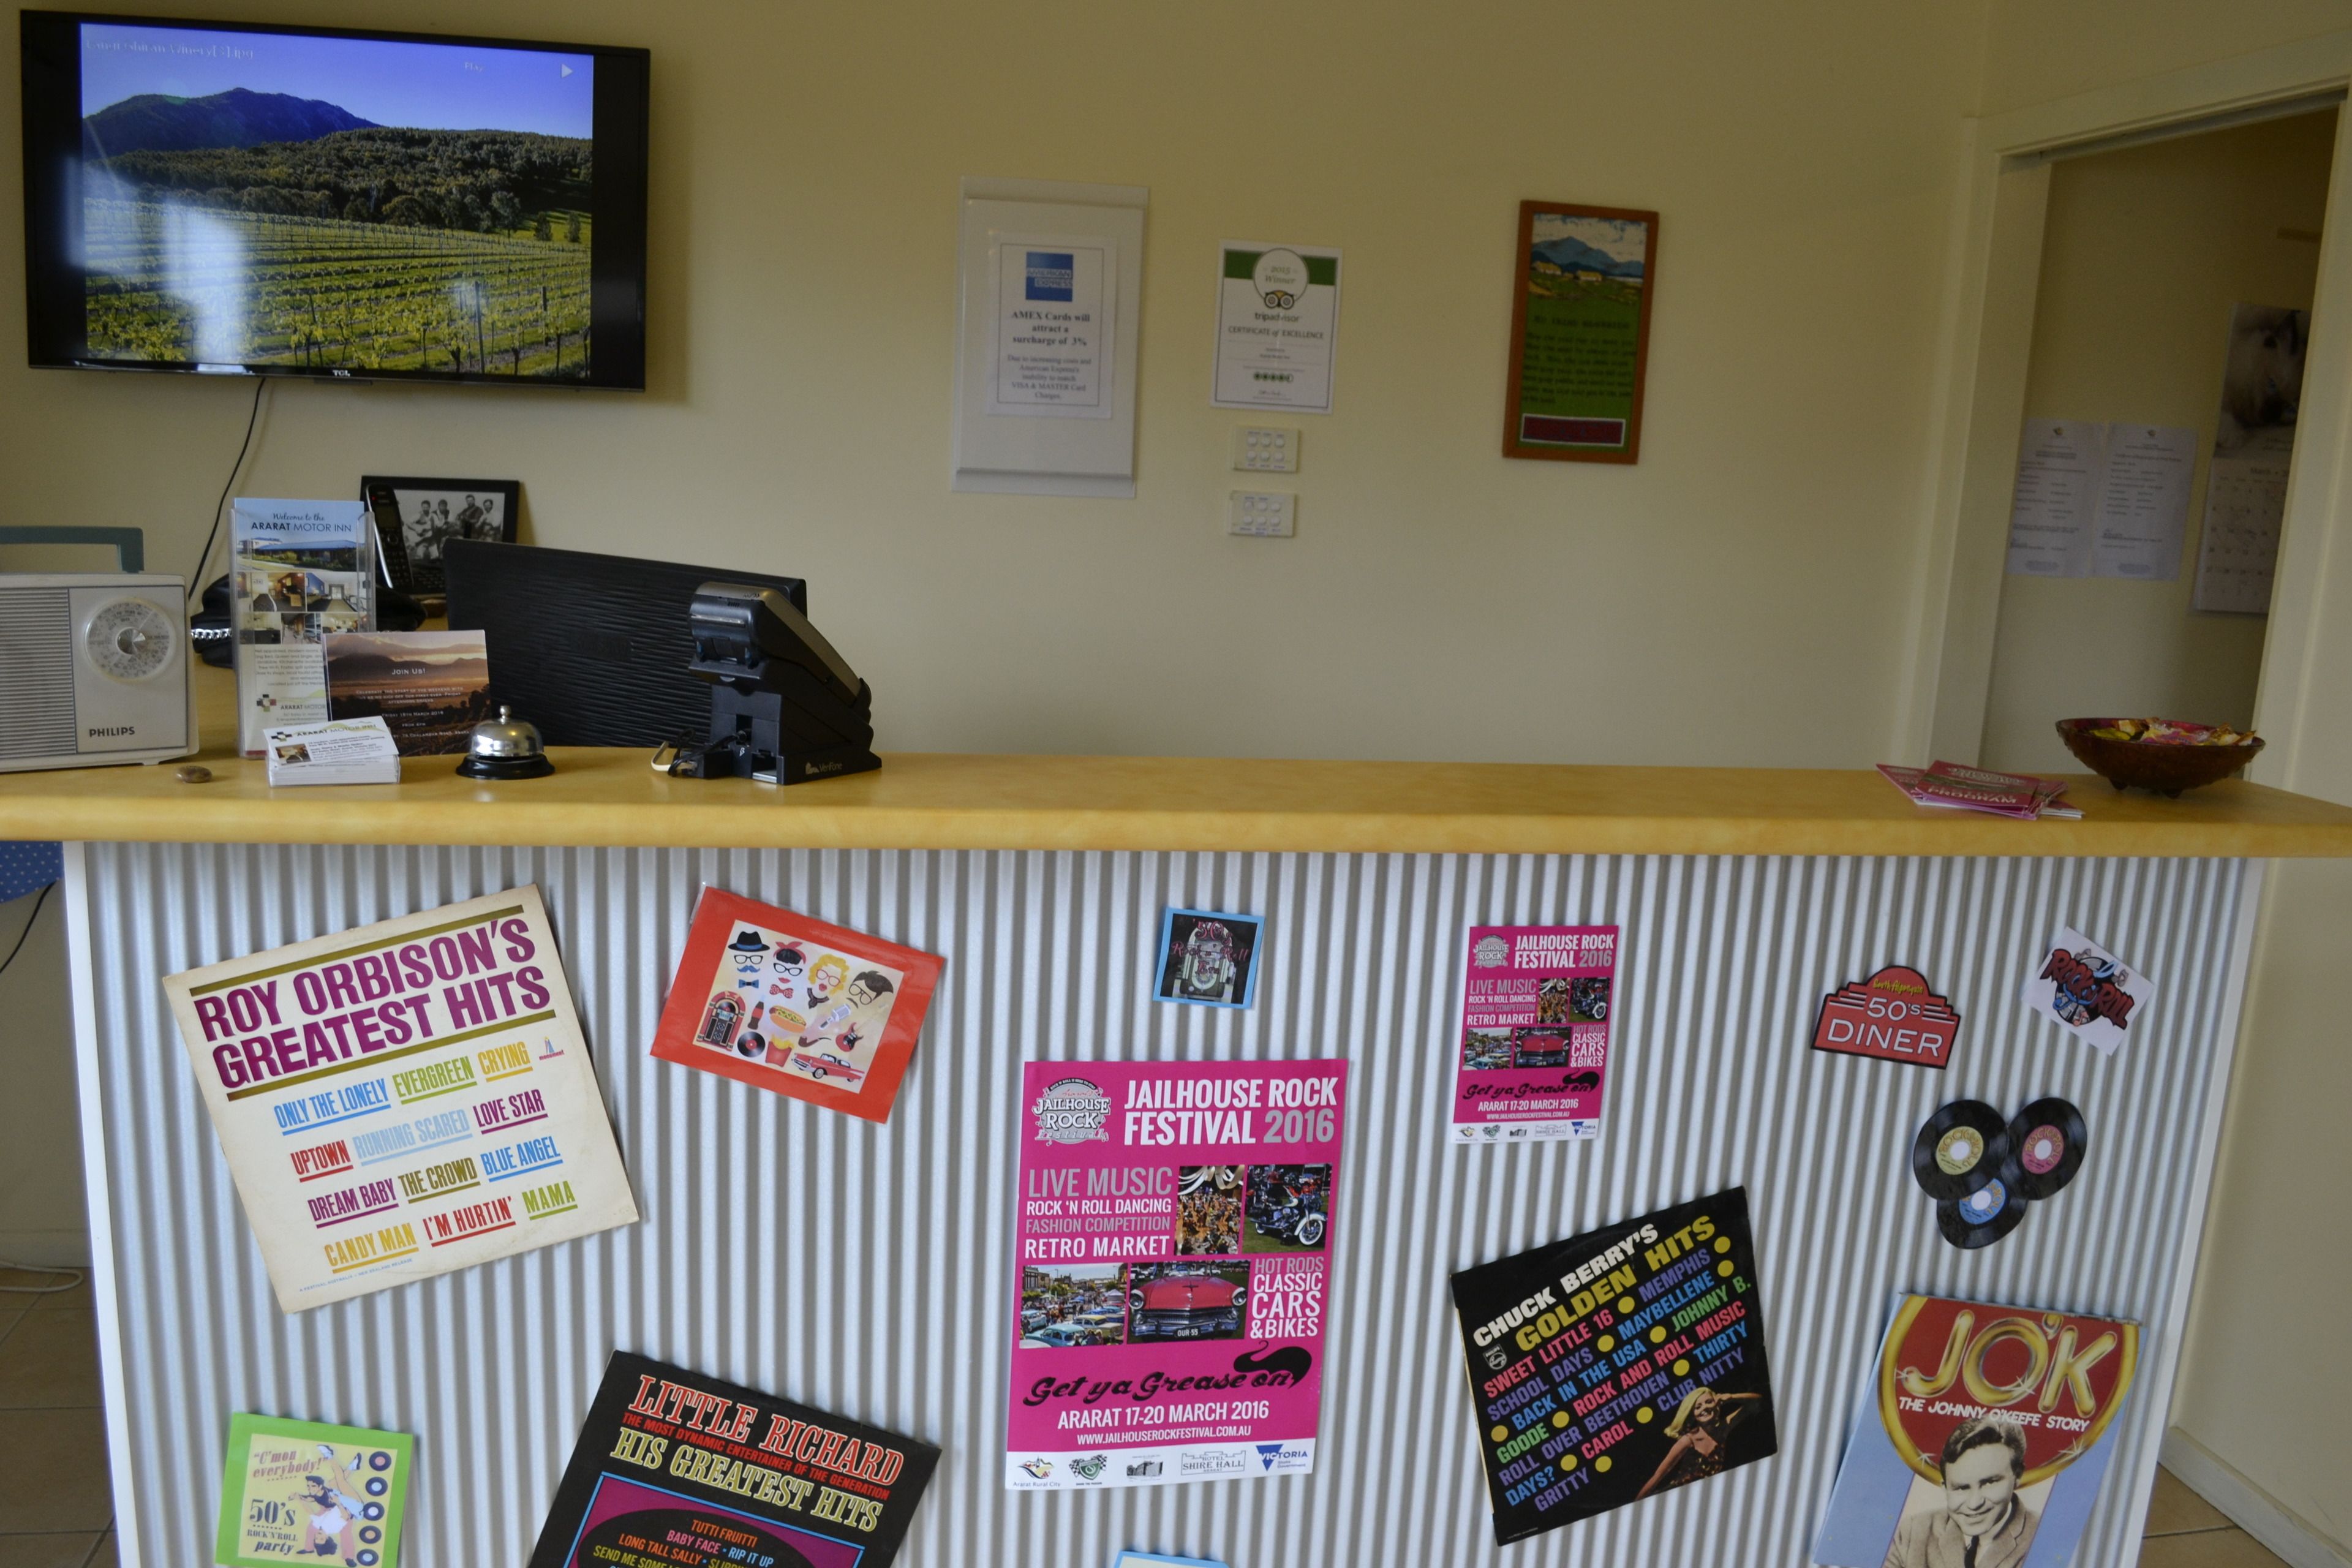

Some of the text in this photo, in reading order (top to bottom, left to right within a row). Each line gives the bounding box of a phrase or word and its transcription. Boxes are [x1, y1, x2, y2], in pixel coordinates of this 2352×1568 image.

[1027, 268, 1071, 277] AMERICAN
[1036, 279, 1073, 287] EXPRESS
[1011, 311, 1042, 320] AMEX
[1045, 312, 1071, 321] Cards
[1012, 337, 1056, 345] surcharge
[1071, 337, 1087, 346] 3%
[1229, 326, 1270, 336] CERTIFICATE
[1283, 330, 1324, 339] EXCELLENCE
[251, 522, 290, 530] ARARAT
[294, 523, 331, 532] MOTOR
[89, 726, 135, 737] PHILIPS
[818, 761, 843, 772] VeriFone
[1515, 934, 1615, 951] JAILHOUSE ROCK
[1514, 951, 1612, 968] FESTIVAL 2016
[194, 919, 535, 1042] ROY ORBISON'S
[213, 966, 551, 1088] GREATEST HITS
[1827, 1019, 1943, 1057] DINER
[1570, 1057, 1603, 1068] &BIKES
[274, 1041, 531, 1128] ONLY THE LONELY EVERGREEN CRYING
[1124, 1079, 1264, 1110] JAILHOUSE
[1268, 1077, 1338, 1107] ROCK
[1033, 1098, 1109, 1115] JAILHOUSE
[1487, 1112, 1570, 1120] WWW.JAILHOUSEROCKFESTIVAL.COM.AU
[290, 1088, 546, 1175] UPTOWN RUNNING SCARED LOVE STAR
[1045, 1112, 1098, 1131] ROCK
[1124, 1108, 1335, 1146] FESTIVAL 2016
[307, 1136, 561, 1222] DREAM BABY THE CROWD BLUE ANGEL
[1028, 1167, 1172, 1199] LIVE MUSIC
[1115, 1198, 1172, 1214] DANCING
[324, 1180, 575, 1267] CANDY MAN HURTIN' MAMA
[1025, 1216, 1170, 1234] FASHION COMPETITION
[1024, 1235, 1170, 1259] RETRO MARKET
[1253, 1272, 1322, 1293] CLASSIC
[1473, 1223, 1658, 1347] CHUCK BERRY'S
[1515, 1215, 1715, 1351] GOLDEN HITS
[1251, 1292, 1321, 1319] CARS
[1250, 1318, 1319, 1340] &BIKES
[1483, 1248, 1711, 1398] SWEET LITTLE 16 MEMPHIS
[1487, 1270, 1715, 1421] SCHOOL DAYS MAYBELLENE
[1511, 1275, 1752, 1431] BACK THE USA JOHNNY B.
[1692, 1320, 1747, 1363] THIRTY
[1901, 1309, 2117, 1418] JO'K
[1023, 1371, 1246, 1406] Get ya Grease
[1058, 1405, 1164, 1430] ARARAT 17-20
[1505, 1347, 1744, 1507] DAYS? CAROL NITTY
[1899, 1396, 2090, 1433] THE JOHNNY O'KEEFE STORY
[628, 1374, 904, 1486] LITTLE RICHARD
[1076, 1425, 1251, 1446] WWW.JAILHOUSEROCKFESTIVAL.COM.AU
[644, 1419, 890, 1501] MOST DYNAMIC ENTERTAINER GENERATION
[1183, 1460, 1243, 1470] SHIRE HALL
[1260, 1451, 1308, 1460] VICTORIA
[610, 1427, 884, 1532] HIS GREATEST HITS
[1534, 1466, 1590, 1512] GRITTY
[249, 1499, 296, 1526] 50's
[666, 1530, 722, 1555] BABY FACE
[691, 1519, 758, 1548] TUTTI FRUITTI
[254, 1540, 295, 1555] party
[618, 1533, 703, 1566] LONG TALL SALLY
